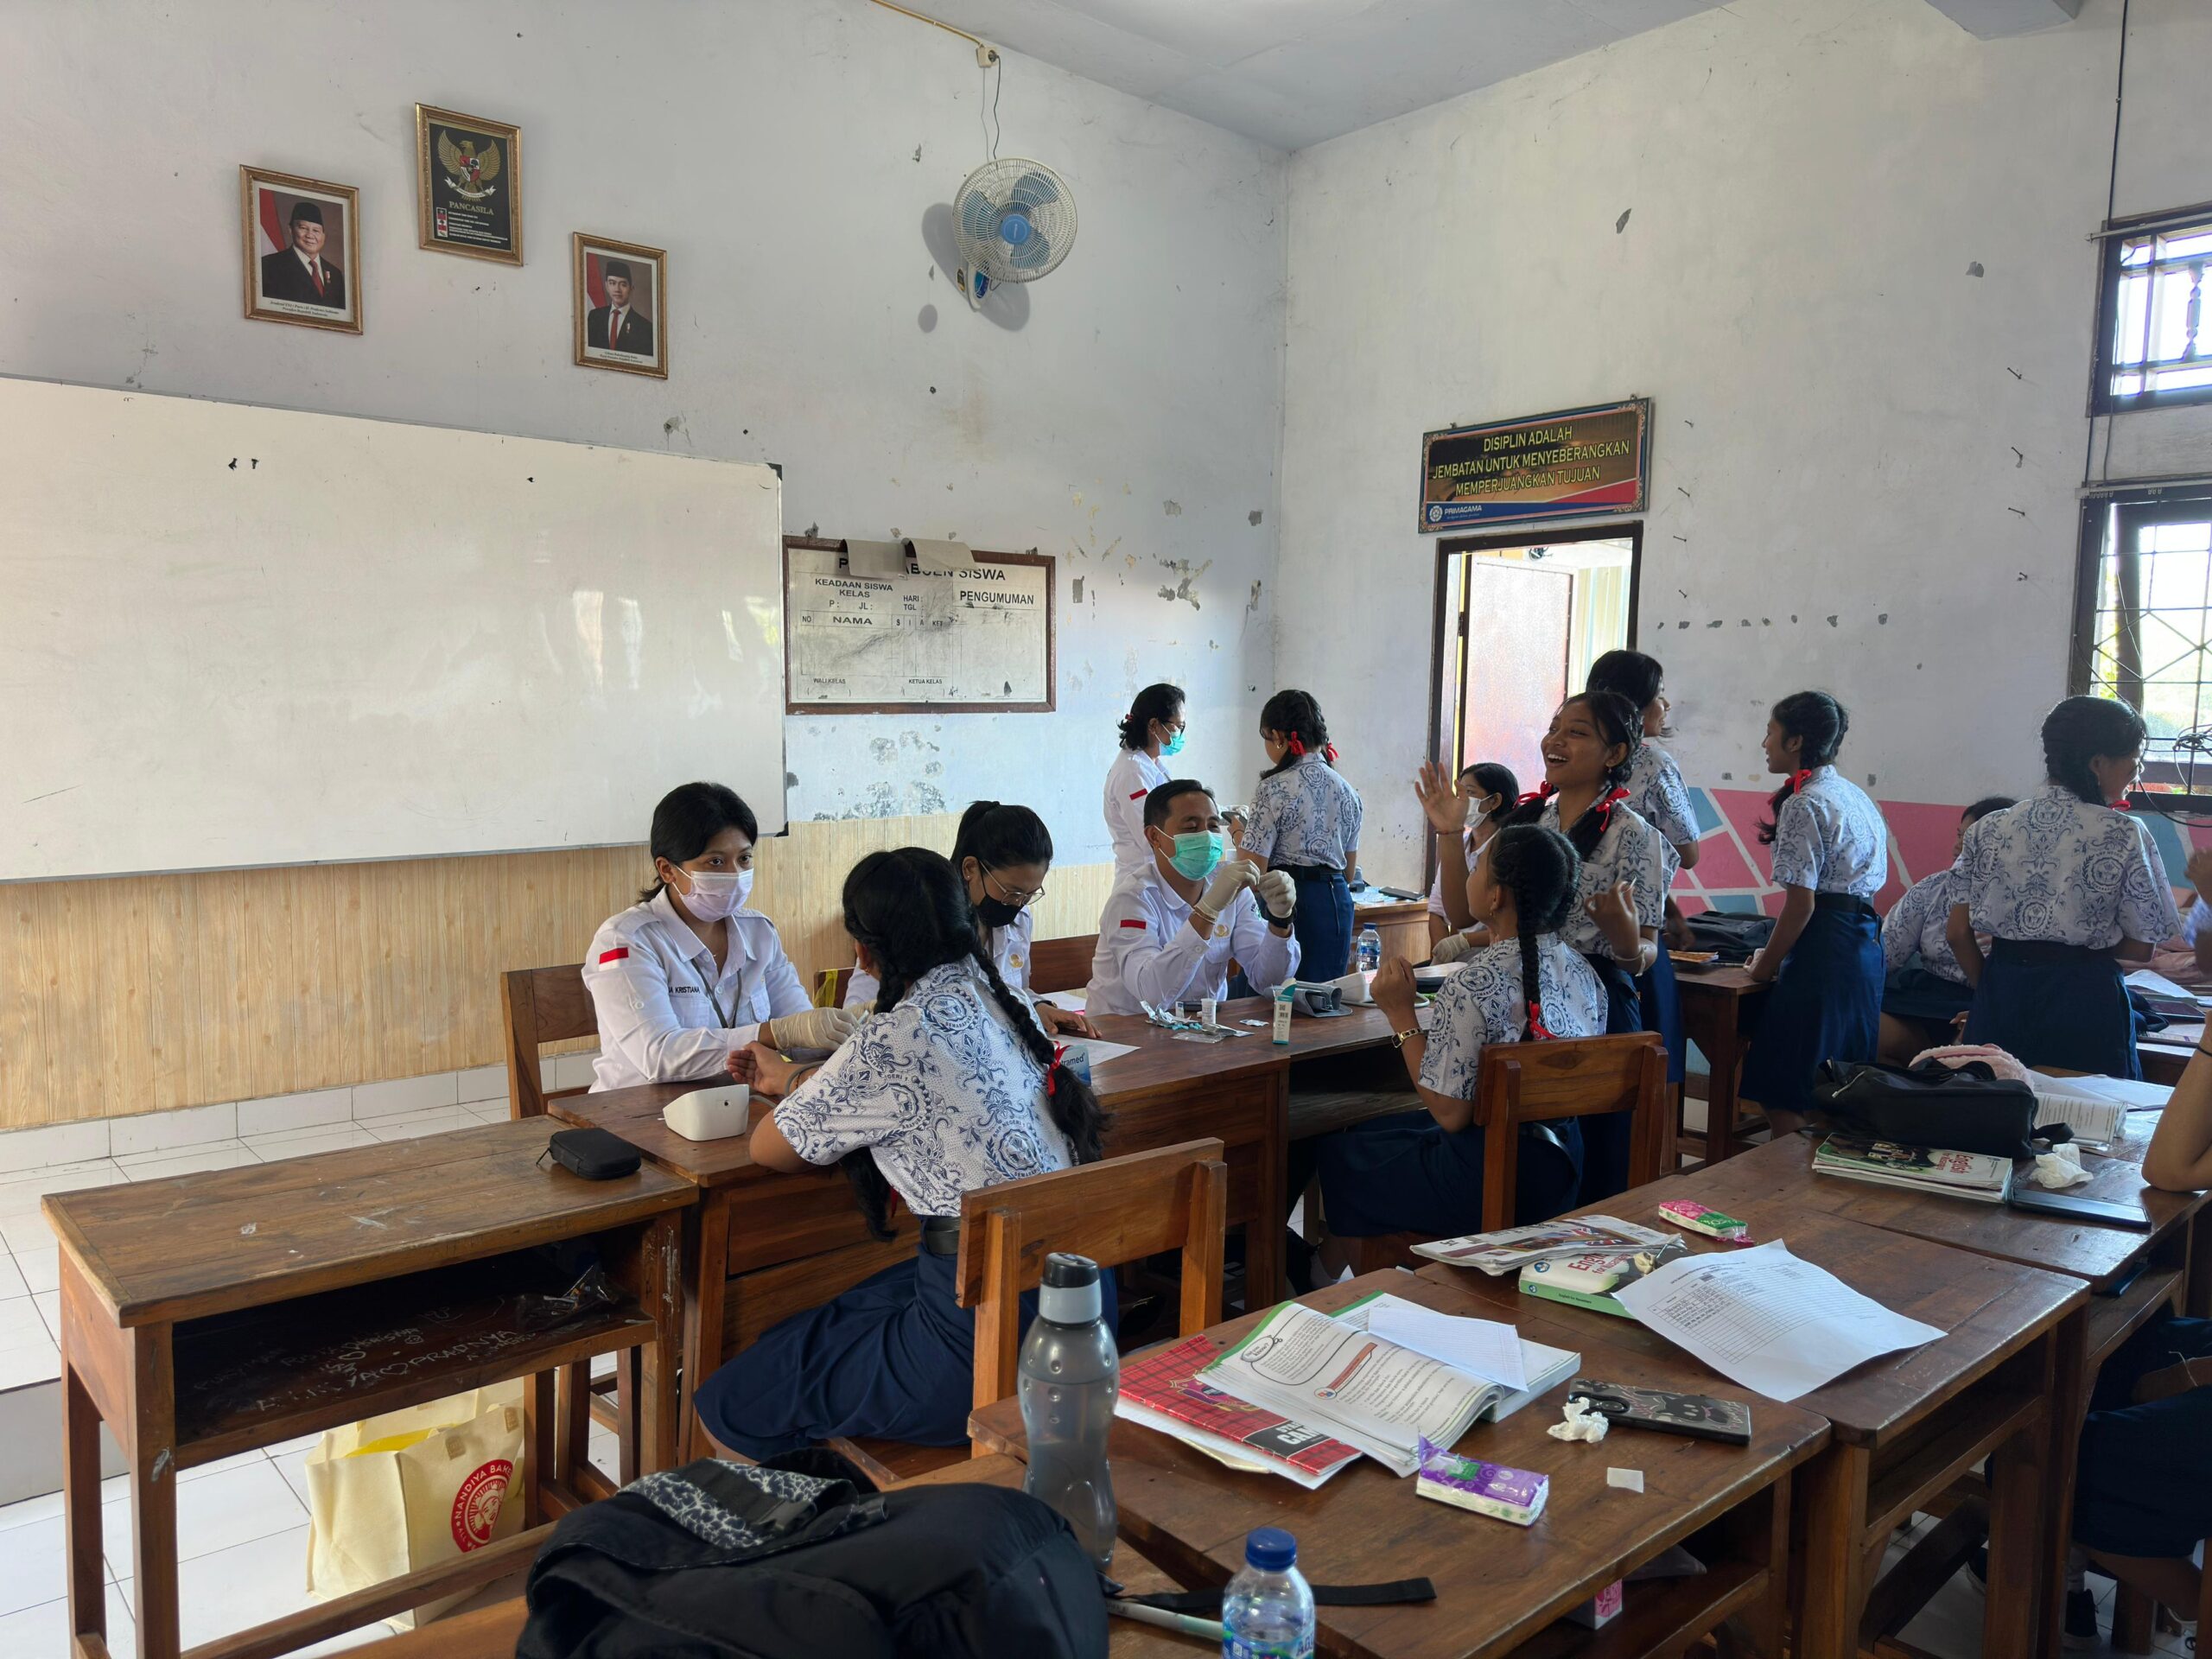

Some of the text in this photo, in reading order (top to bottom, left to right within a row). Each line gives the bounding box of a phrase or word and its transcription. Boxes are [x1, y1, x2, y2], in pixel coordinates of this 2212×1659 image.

[449, 201, 494, 215] PANCASILA
[1484, 426, 1573, 453] DISIPLIN ADALAH
[1433, 440, 1630, 480] JEMBATAN UNTUK MENYEBERANGKAN
[1456, 466, 1600, 496] MEMPERJUANGKAN TUJUAN
[1444, 504, 1483, 515] PRIMAGAMA
[815, 578, 893, 592] KEADAAN SISWA
[839, 589, 870, 598] KELAS
[960, 590, 1034, 605] PENGUMUMAN
[832, 616, 873, 625] NAMA
[454, 1470, 487, 1520] NANDIYA
